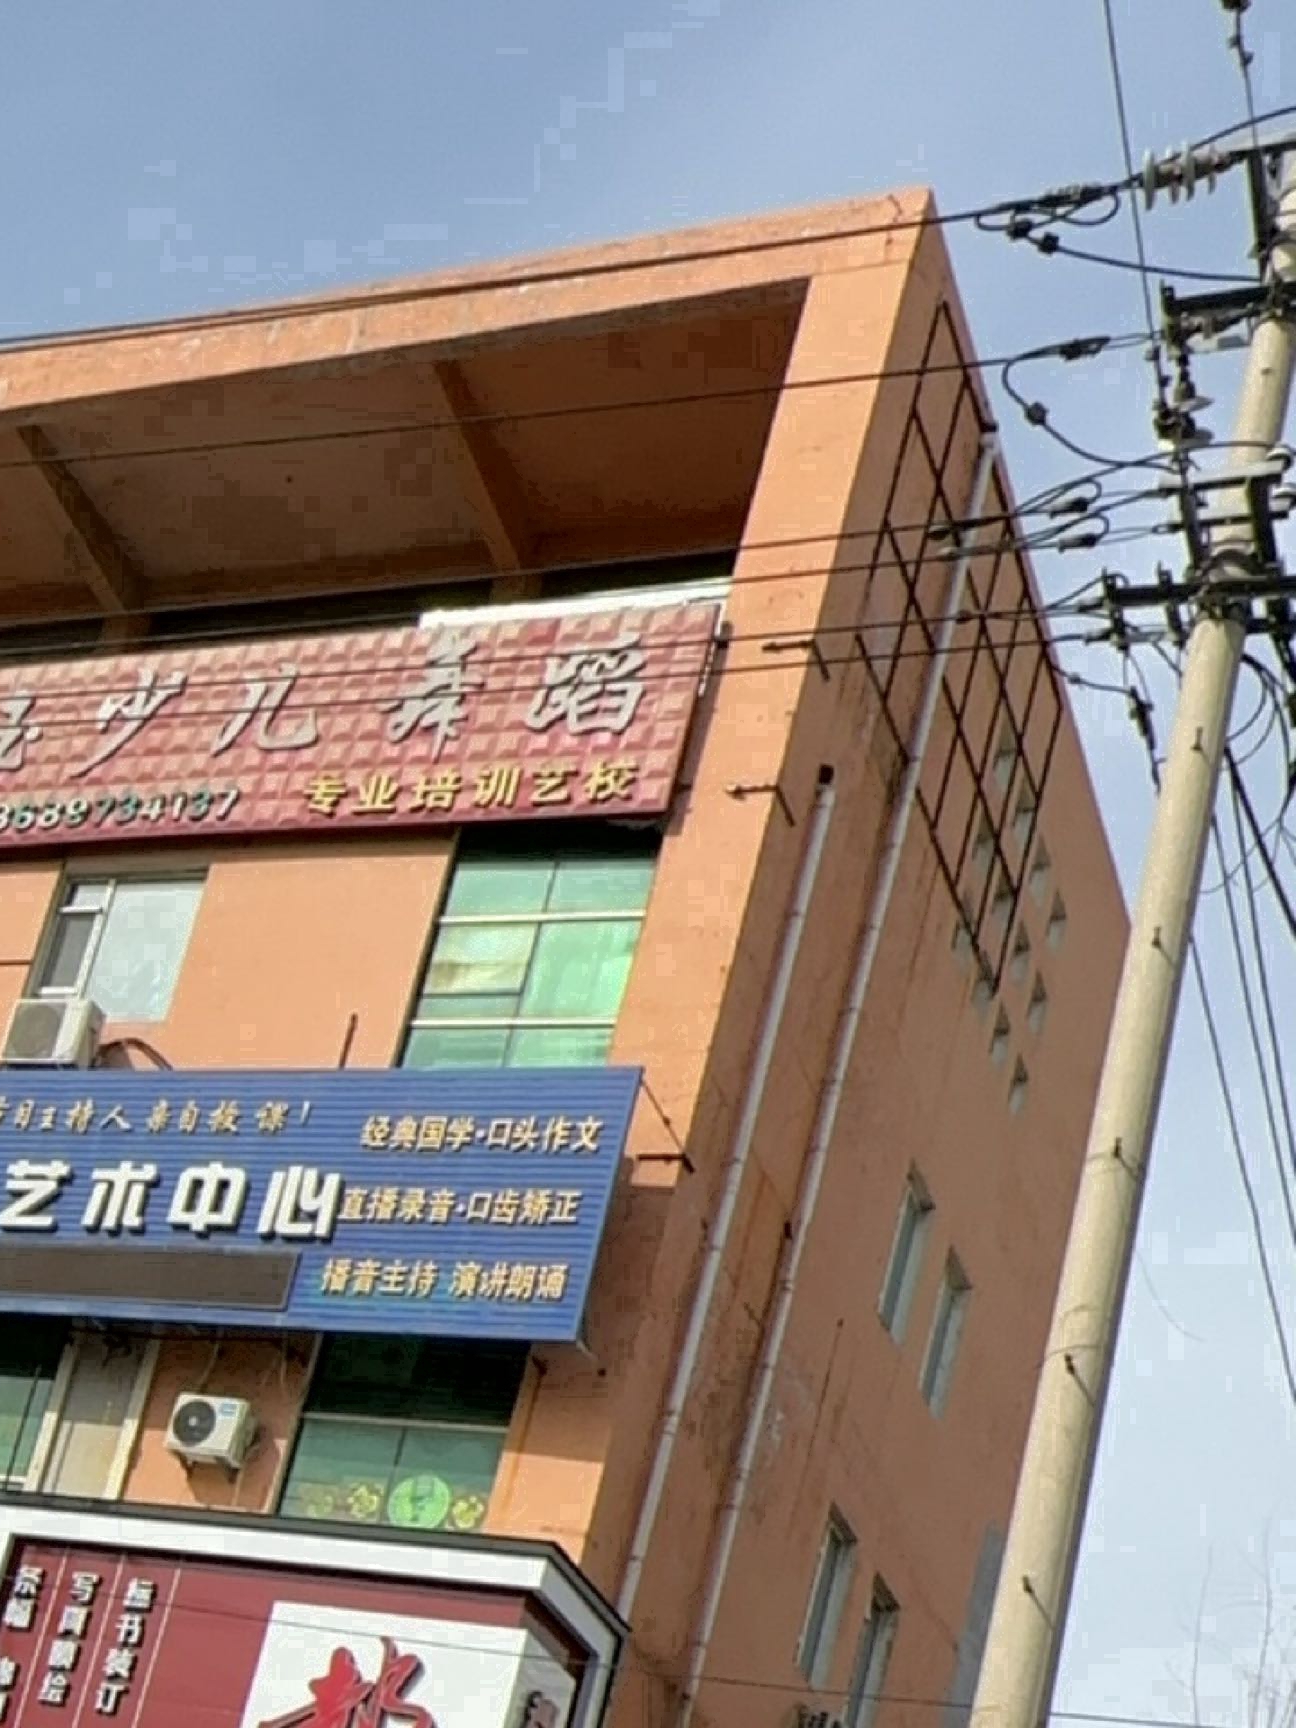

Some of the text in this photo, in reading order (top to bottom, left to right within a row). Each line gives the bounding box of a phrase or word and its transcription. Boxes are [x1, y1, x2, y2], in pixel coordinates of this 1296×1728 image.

[306, 761, 640, 815] 专业培训艺校
